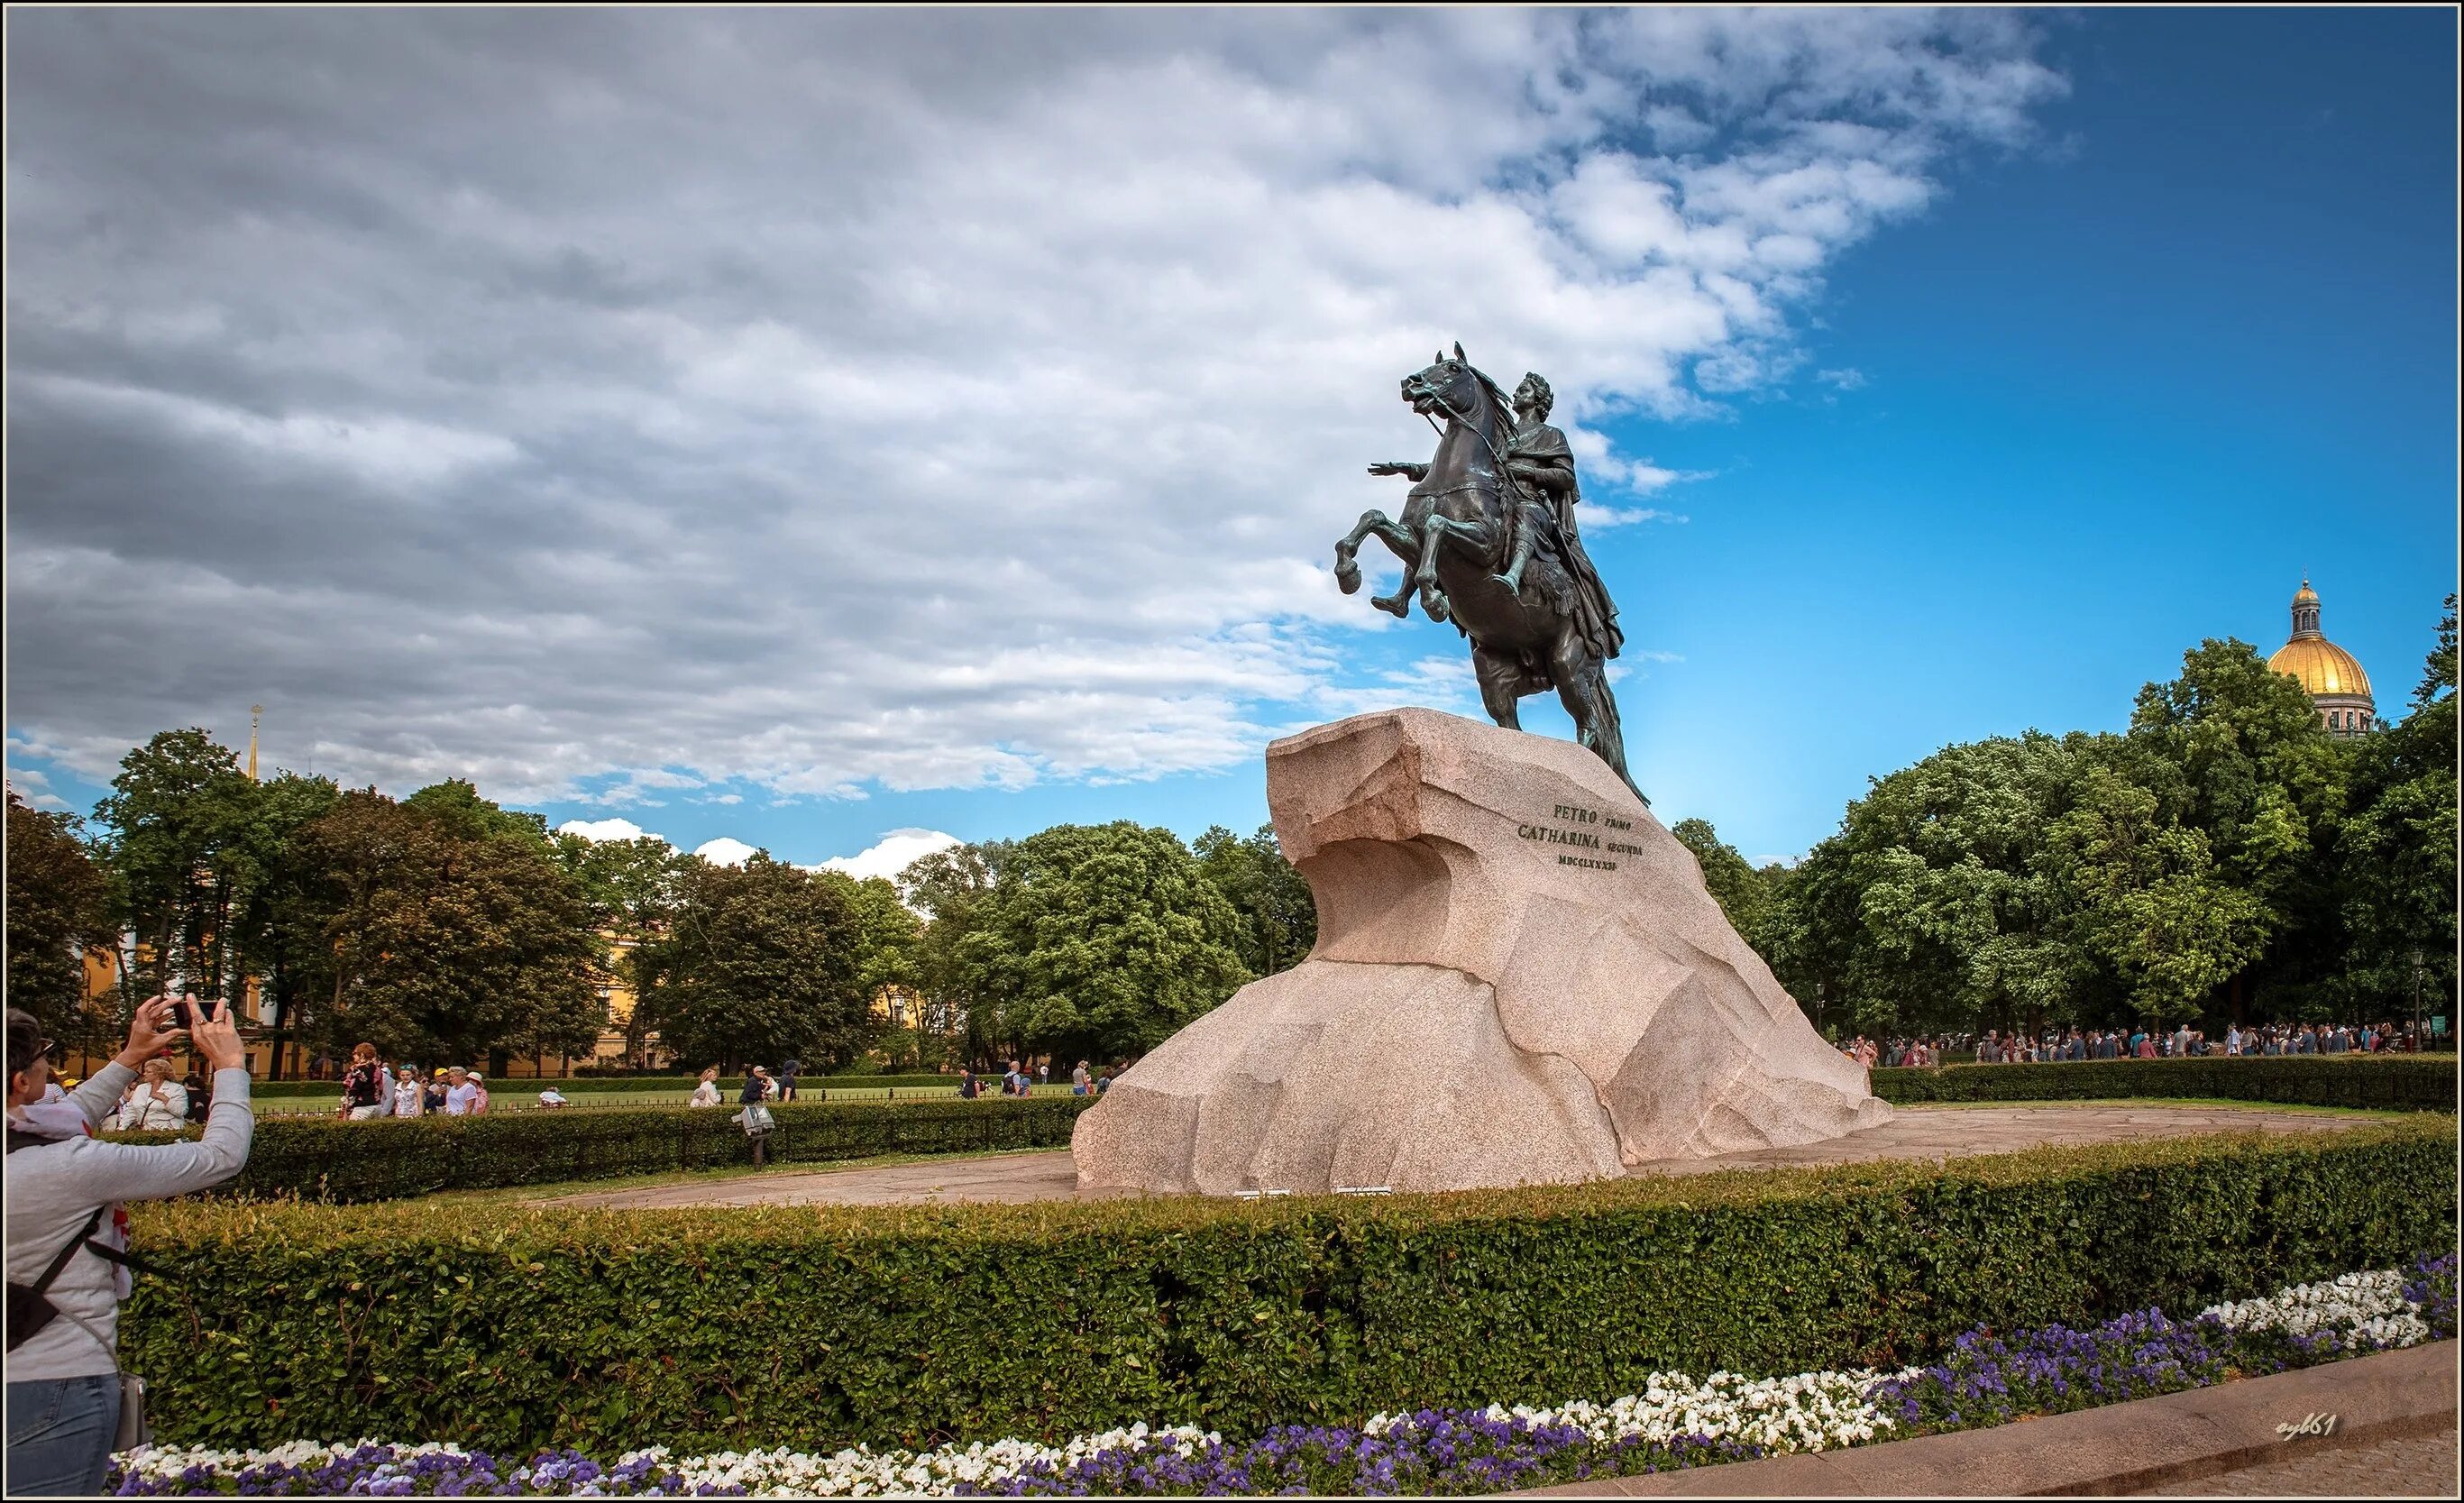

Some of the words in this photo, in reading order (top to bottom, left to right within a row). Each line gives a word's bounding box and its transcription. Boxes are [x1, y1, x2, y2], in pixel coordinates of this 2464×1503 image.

[1553, 804, 1598, 824] PETRO
[1605, 818, 1632, 831] PRIMO
[1517, 824, 1600, 849] CATHARINA
[1607, 842, 1643, 857] SECUNDA
